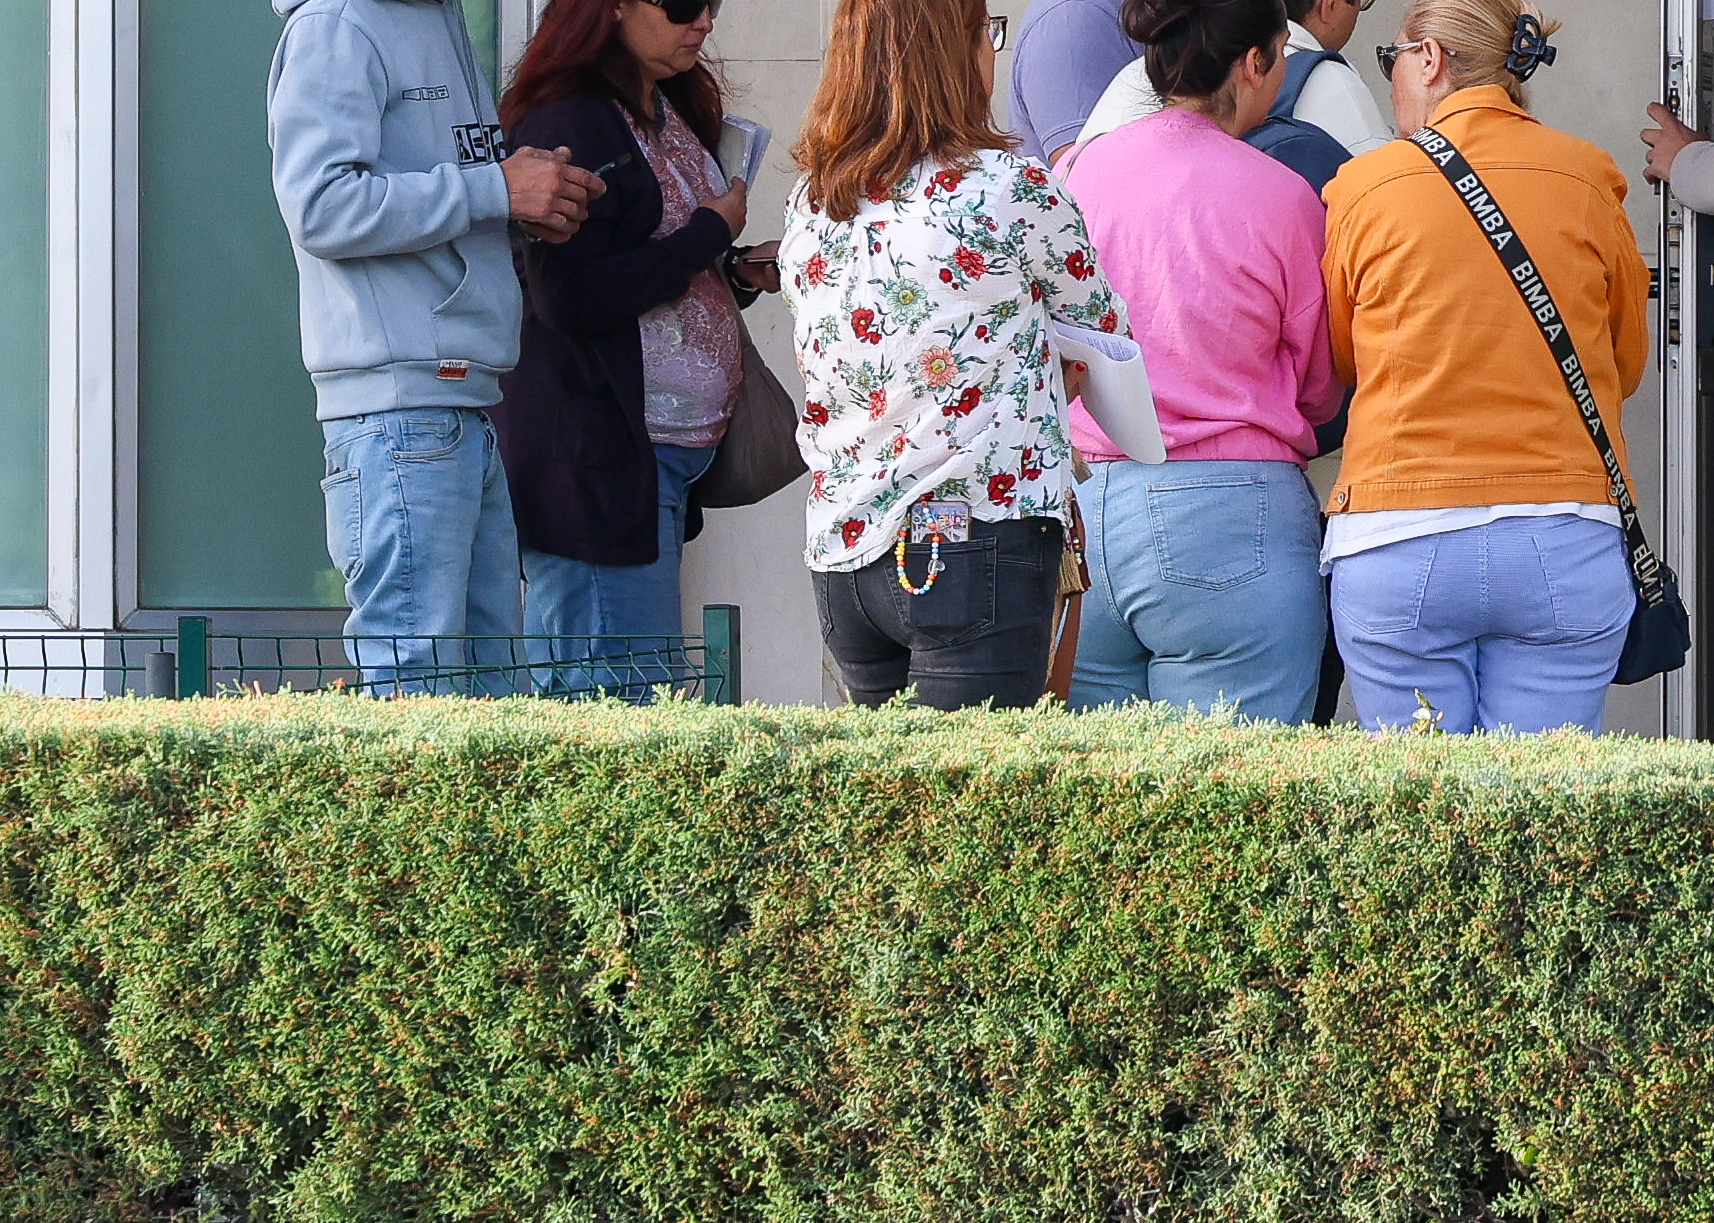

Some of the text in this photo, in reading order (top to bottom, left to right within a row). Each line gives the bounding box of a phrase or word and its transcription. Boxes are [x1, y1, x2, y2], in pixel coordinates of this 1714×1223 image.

[1454, 172, 1514, 251] BIMBA
[1511, 260, 1563, 343] BIMBA
[1561, 353, 1601, 436] BIMBA
[1603, 448, 1636, 531] BIMBA
